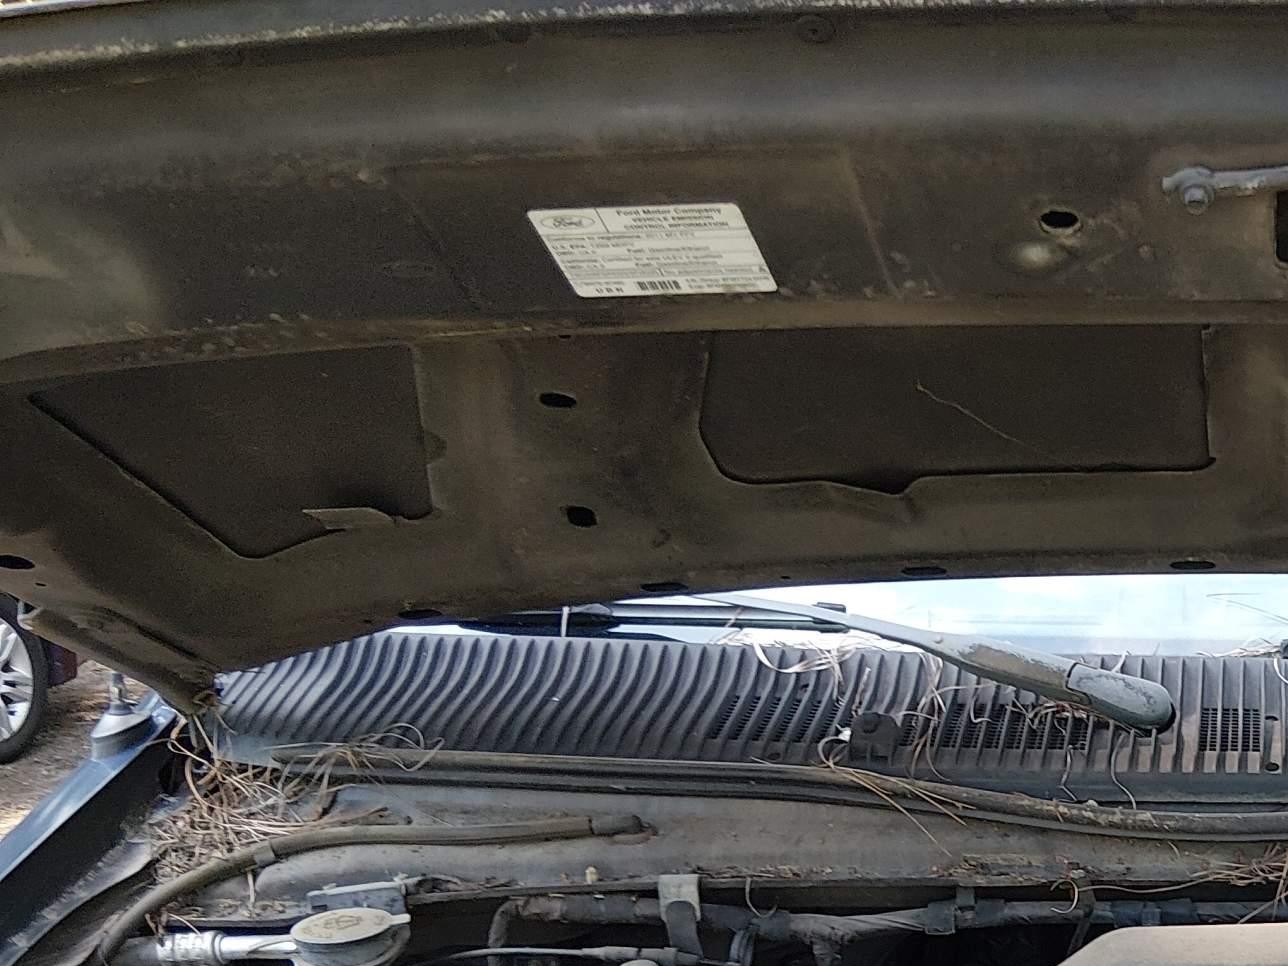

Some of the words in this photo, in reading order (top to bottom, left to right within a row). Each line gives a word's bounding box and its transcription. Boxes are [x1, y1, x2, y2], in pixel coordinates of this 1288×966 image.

[615, 208, 641, 216] Ford
[642, 207, 670, 215] Motor
[673, 206, 722, 216] Company
